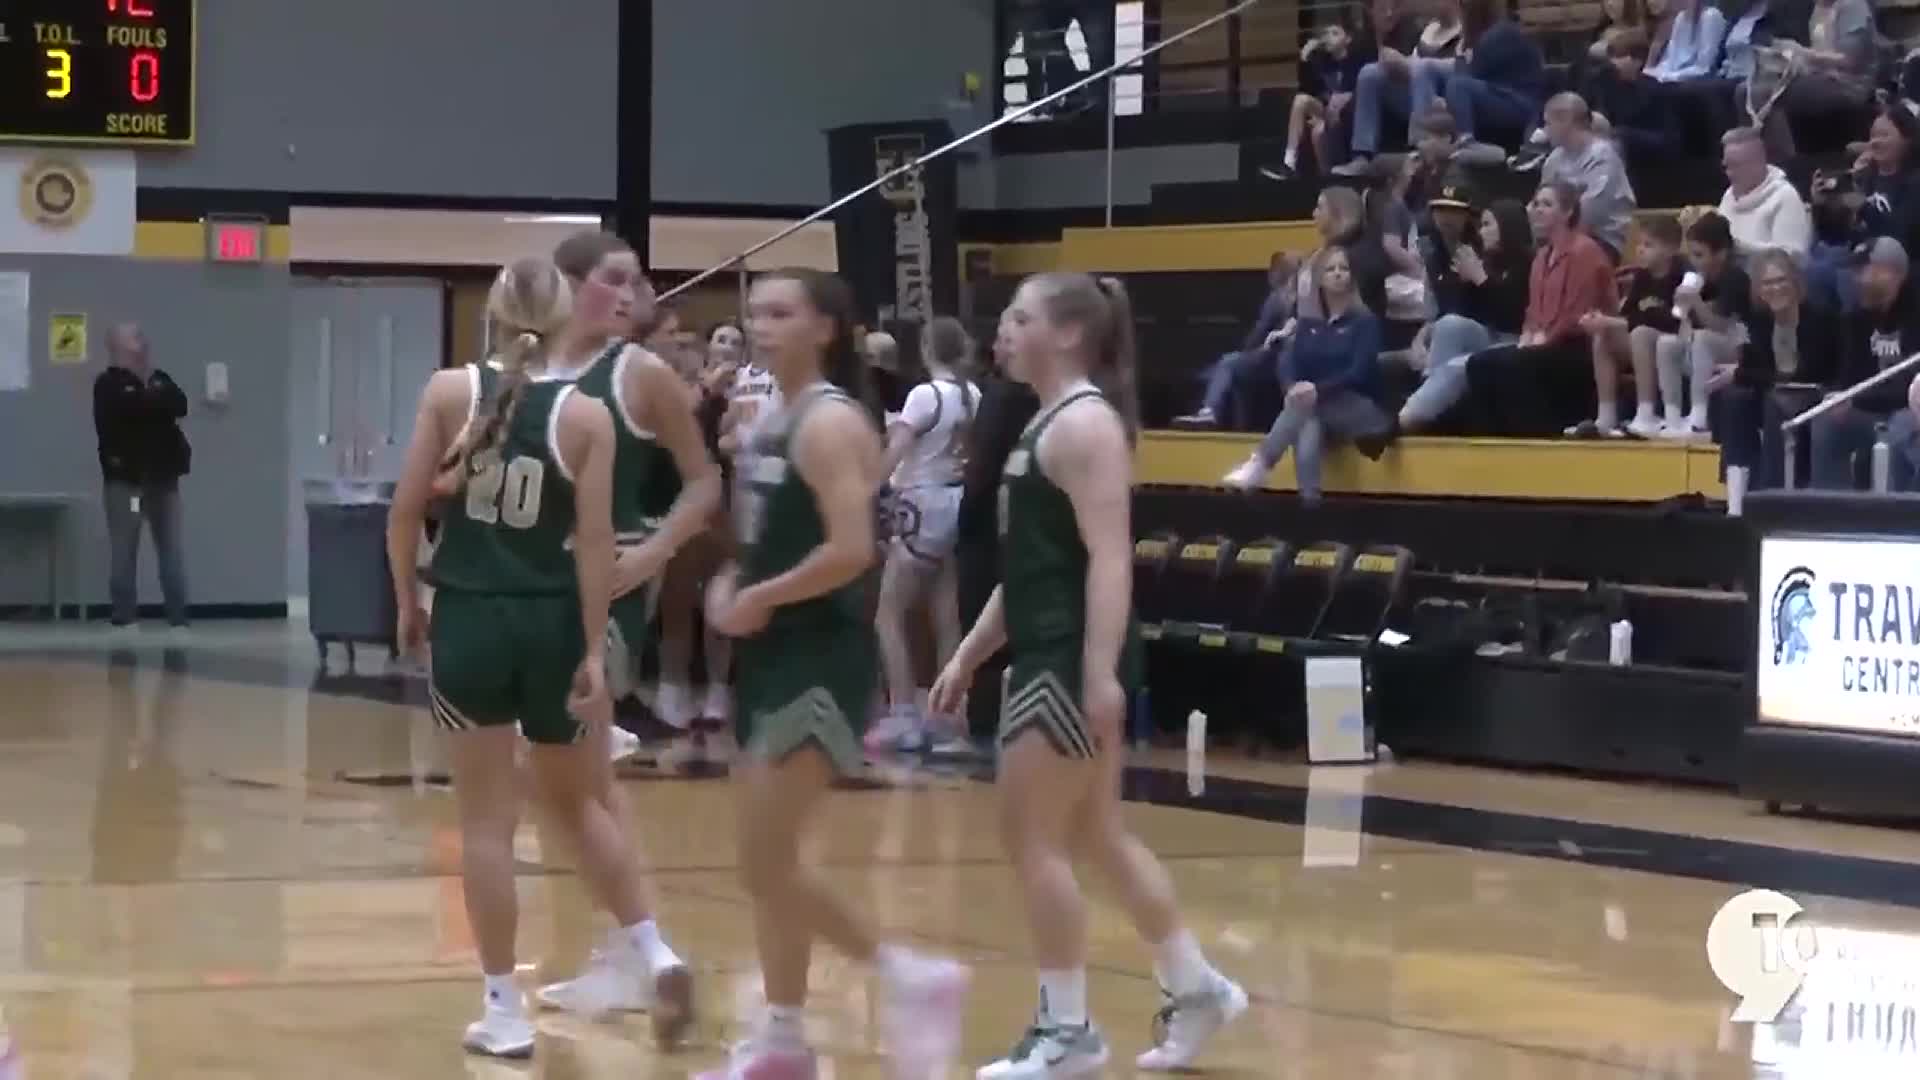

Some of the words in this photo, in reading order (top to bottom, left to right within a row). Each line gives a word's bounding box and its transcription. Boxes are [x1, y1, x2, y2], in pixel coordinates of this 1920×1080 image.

[106, 26, 168, 48] FOULS
[46, 49, 71, 98] 3
[130, 53, 159, 101] 0
[106, 114, 168, 134] SCORE
